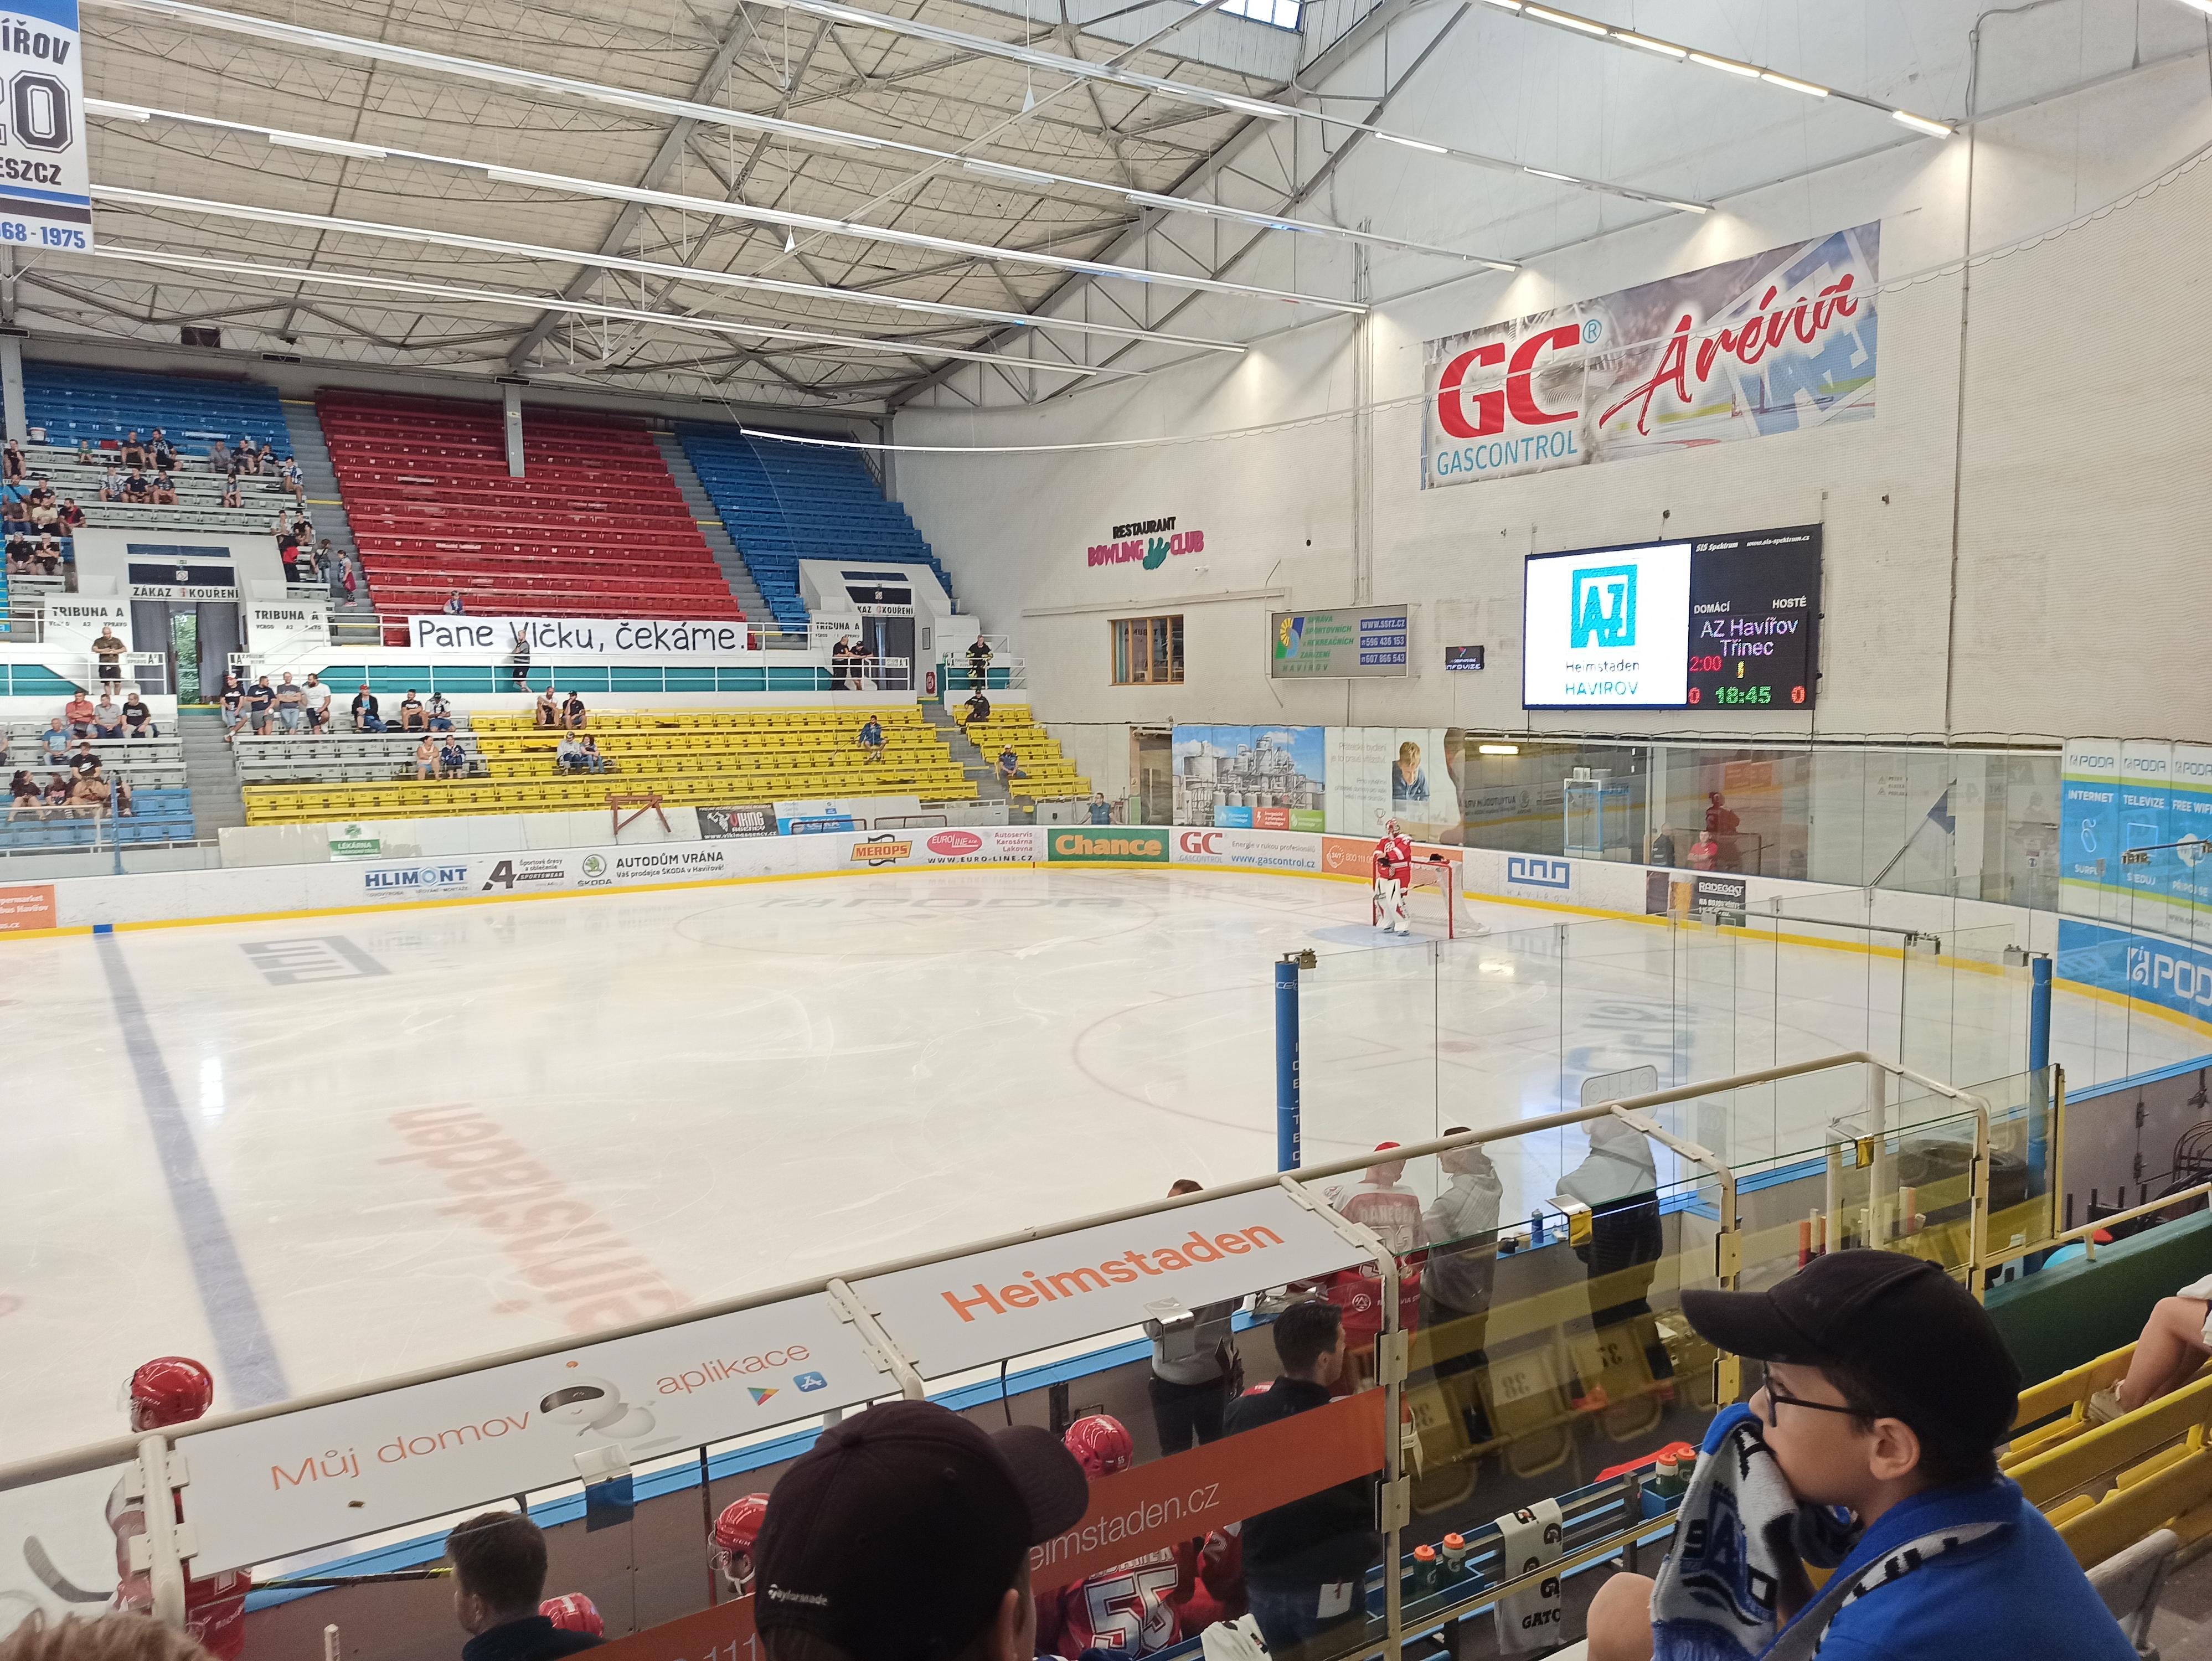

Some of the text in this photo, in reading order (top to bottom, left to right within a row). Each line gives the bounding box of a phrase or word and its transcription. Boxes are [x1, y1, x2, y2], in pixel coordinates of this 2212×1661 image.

[0, 69, 73, 154] 0
[0, 221, 28, 243] 68
[40, 226, 86, 249] 1975
[1599, 272, 1859, 436] Aréna
[1438, 323, 1581, 439] GC
[1437, 430, 1578, 476] GASCONTROL
[1112, 516, 1177, 539] RESTAURANT
[1087, 530, 1204, 568] BOWLING CLUB
[1708, 541, 1739, 552] Spektrum
[133, 585, 239, 599] ZÁKAZ KOUŘENÍ
[51, 606, 125, 617] TRIBUNA A
[1694, 595, 1807, 615] DOMÁCÍ HOSTÉ
[255, 610, 305, 621] TRIBUNA
[1307, 615, 1333, 625] SPRÁVA
[1304, 625, 1352, 636] SPORTOVNÍCH
[1362, 618, 1406, 630] www.ssrz.cz
[1700, 616, 1799, 638] AZ Havířov
[418, 620, 745, 653] Pane Vlčku, čekáme.
[1307, 637, 1354, 646] REKREAČNÍCH
[1393, 636, 1405, 646] 153
[1719, 638, 1775, 657] Třinec
[1565, 659, 1639, 673] Heimstaden
[1689, 656, 1723, 672] 2:00
[1689, 685, 1806, 705] 0 18:45 0
[2079, 755, 2115, 768] PODA
[2133, 759, 2166, 772] PODA
[2068, 790, 2114, 803] INTERNET
[2123, 795, 2165, 808] TELEVIZE
[2172, 799, 2192, 812] FREE
[729, 811, 765, 827] VIKING
[337, 841, 373, 850] LÉKÁRNA
[1055, 833, 1162, 856] Chance
[1179, 832, 1223, 855] GC
[1231, 840, 1255, 849] Energie
[1261, 841, 1280, 850] rukou
[1280, 843, 1316, 853] profesionálů
[855, 845, 908, 858] MEROPS
[1178, 854, 1223, 864] GASCONTROL
[1345, 853, 1357, 862] 800
[616, 851, 724, 869] AUTODŮM VRÁNA
[1231, 854, 1316, 869] www.gascontrol.cz
[365, 866, 467, 887] HLIMONT
[616, 869, 630, 878] Váš
[631, 868, 661, 879] prodejce
[661, 866, 686, 875] ŠKODA
[2126, 874, 2156, 886] SEDUJ
[577, 878, 613, 887] ŠKODA
[1699, 881, 1744, 897] RADEGAST
[941, 1225, 1286, 1323] Heimstaden
[656, 1344, 811, 1395] aplikace
[269, 1411, 530, 1492] Můj domov
[1030, 1482, 1220, 1571] eimstaden.cz
[1083, 1562, 1179, 1659] 55
